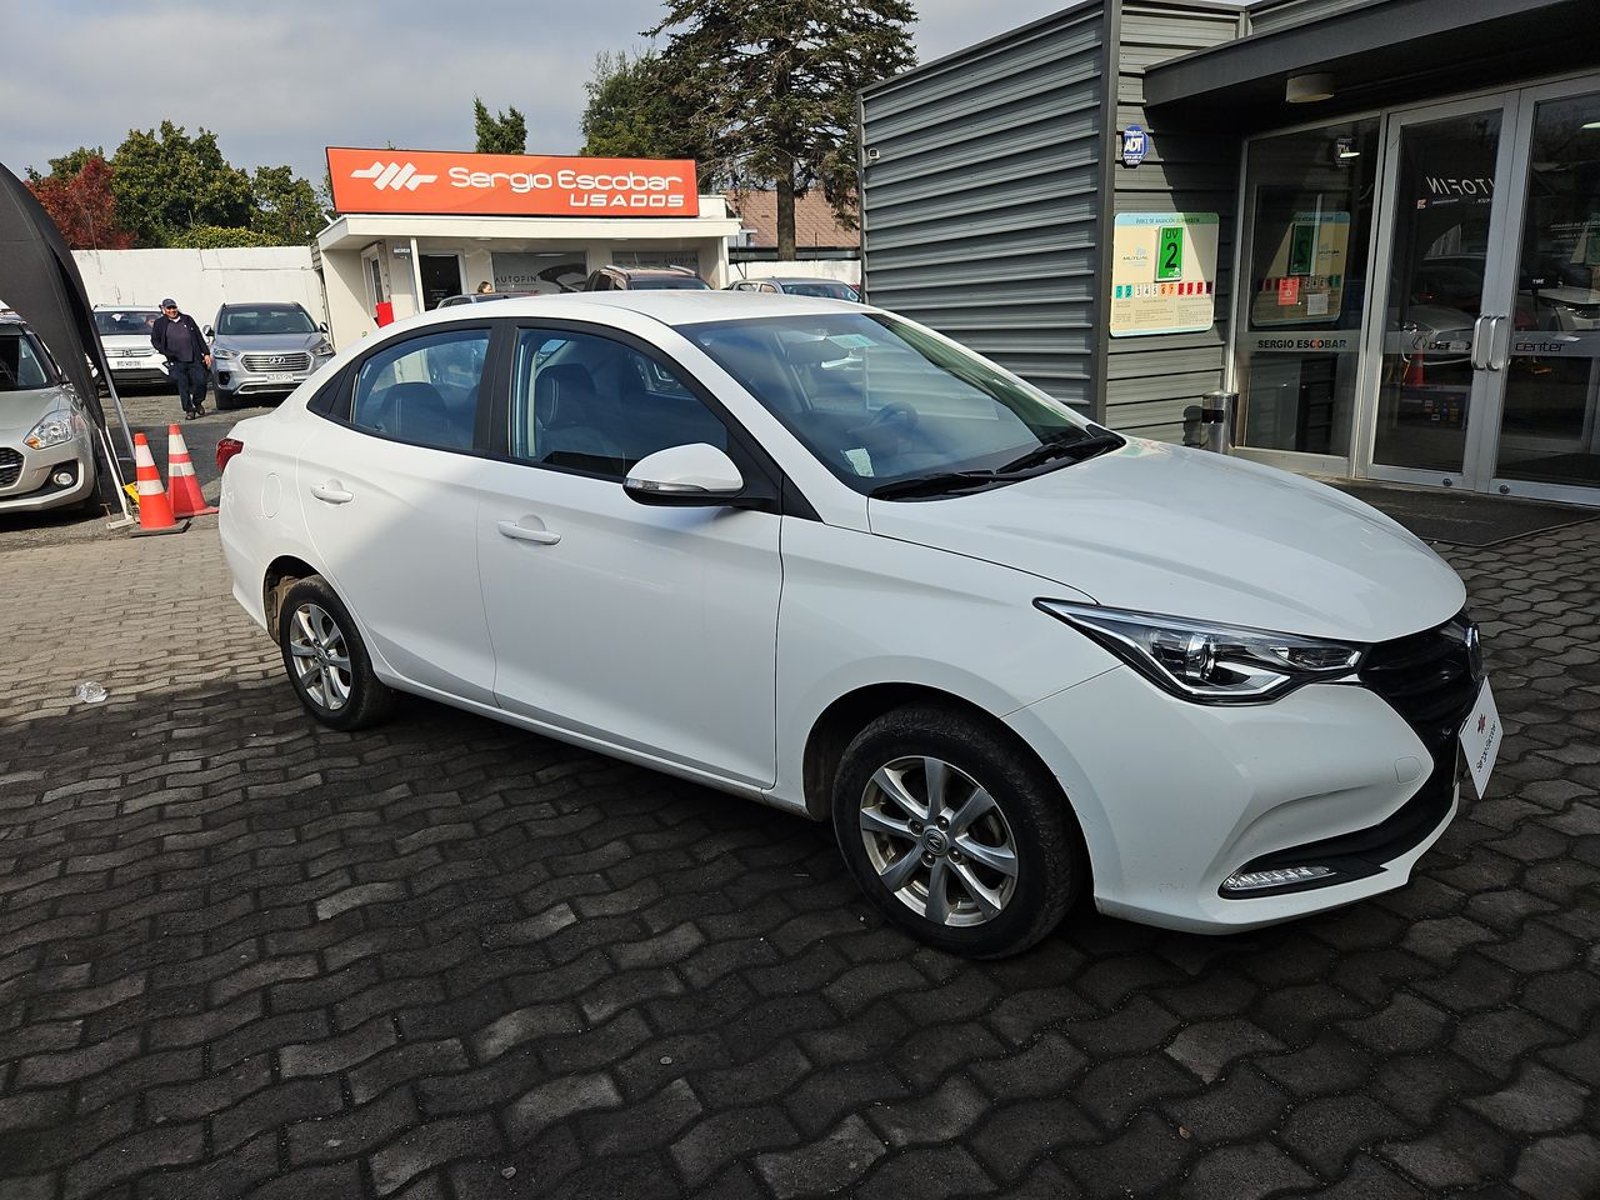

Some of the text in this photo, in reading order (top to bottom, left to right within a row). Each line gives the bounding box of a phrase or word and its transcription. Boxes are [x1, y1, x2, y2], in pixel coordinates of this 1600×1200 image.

[1125, 137, 1142, 151] ADT
[448, 166, 683, 193] Sergio Escobar
[570, 193, 684, 207] USADOS
[1166, 229, 1178, 239] UV
[1165, 242, 1178, 268] 2
[495, 275, 537, 284] AUTOFIN
[1258, 340, 1346, 348] SERGIO ESCOBAR
[1515, 342, 1565, 351] center
